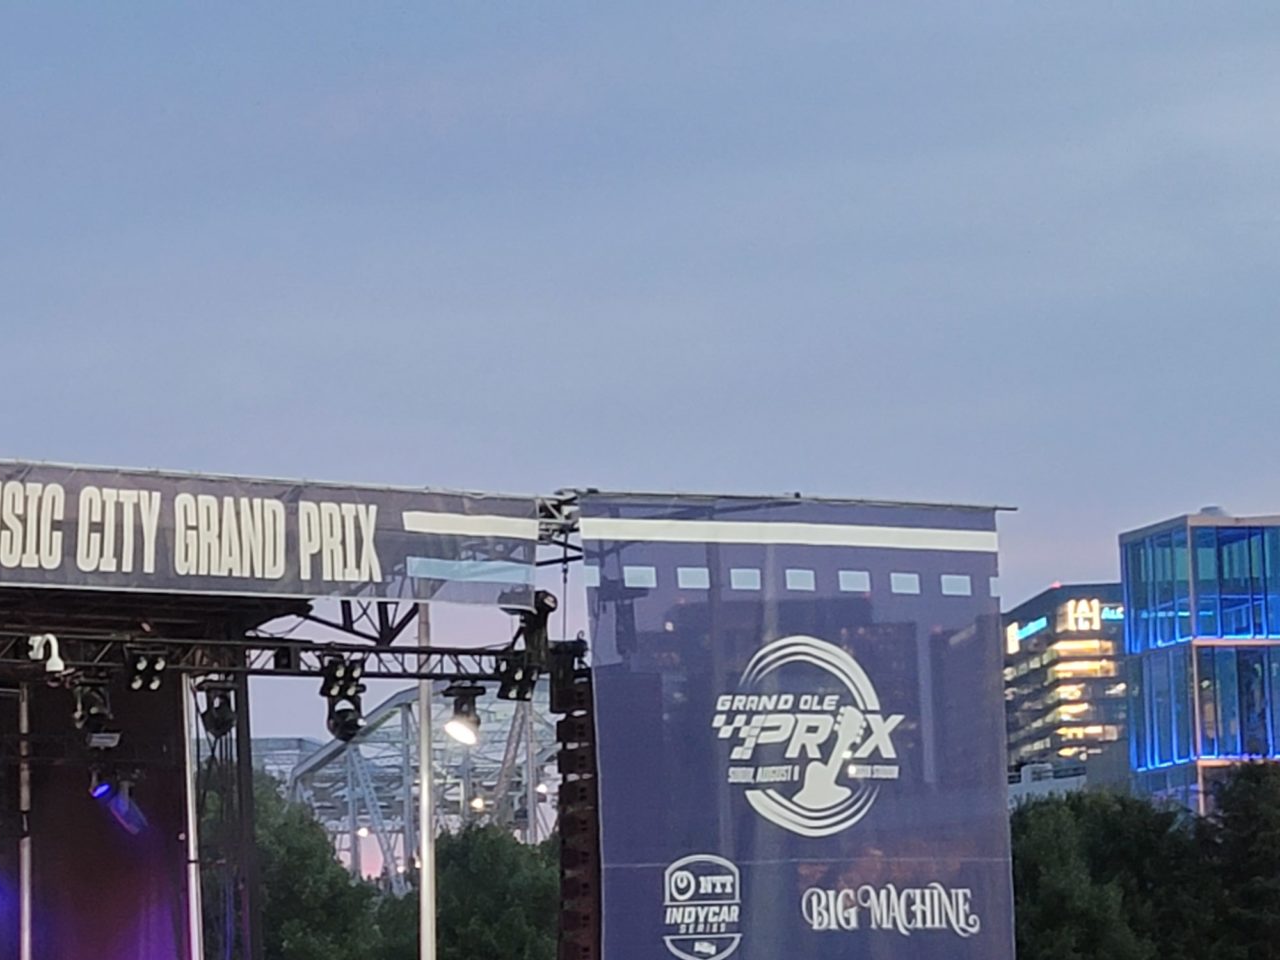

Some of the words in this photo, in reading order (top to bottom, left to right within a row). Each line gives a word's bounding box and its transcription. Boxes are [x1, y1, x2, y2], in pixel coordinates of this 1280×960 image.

[78, 487, 162, 573] CITY
[174, 492, 285, 579] GRAND
[299, 500, 383, 583] PRIX
[716, 694, 794, 711] GRAND
[799, 694, 839, 711] OLE
[698, 875, 734, 894] NTT
[665, 905, 740, 924] INDYCAR
[801, 886, 857, 931] BIG
[857, 882, 981, 937] MACHINE
[678, 923, 727, 934] SERIES
